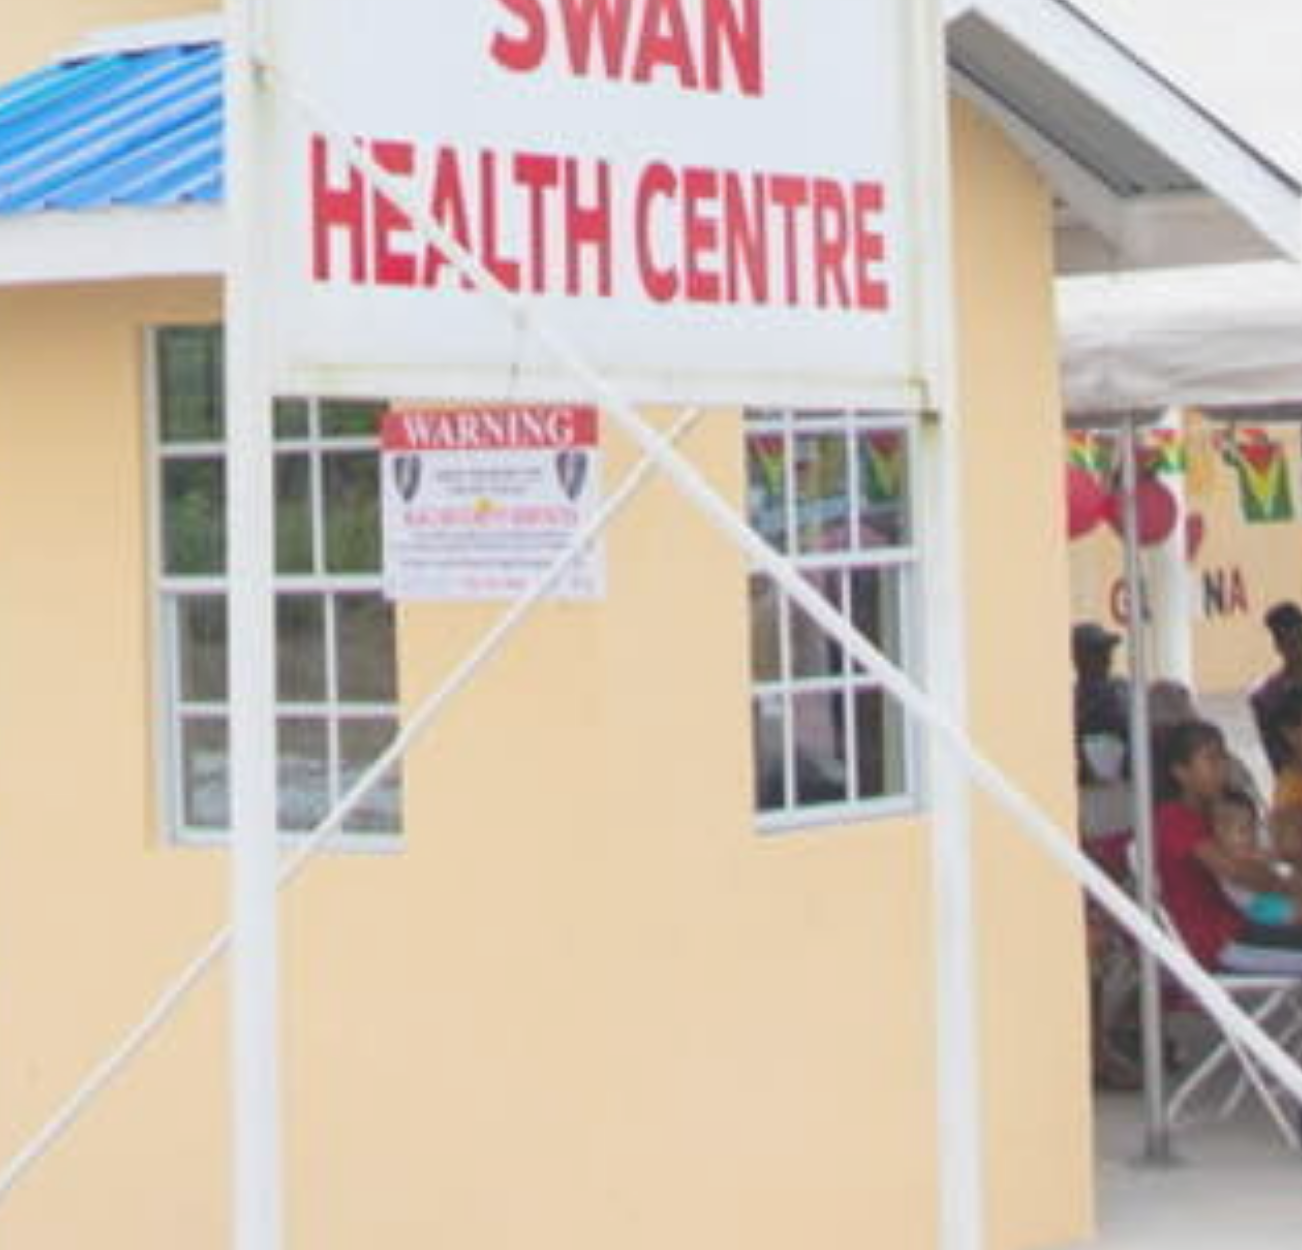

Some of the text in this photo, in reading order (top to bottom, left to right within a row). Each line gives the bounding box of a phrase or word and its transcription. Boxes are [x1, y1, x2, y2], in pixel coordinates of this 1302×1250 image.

[309, 133, 889, 311] HEALTH CENTRE
[403, 409, 574, 448] WARNING
